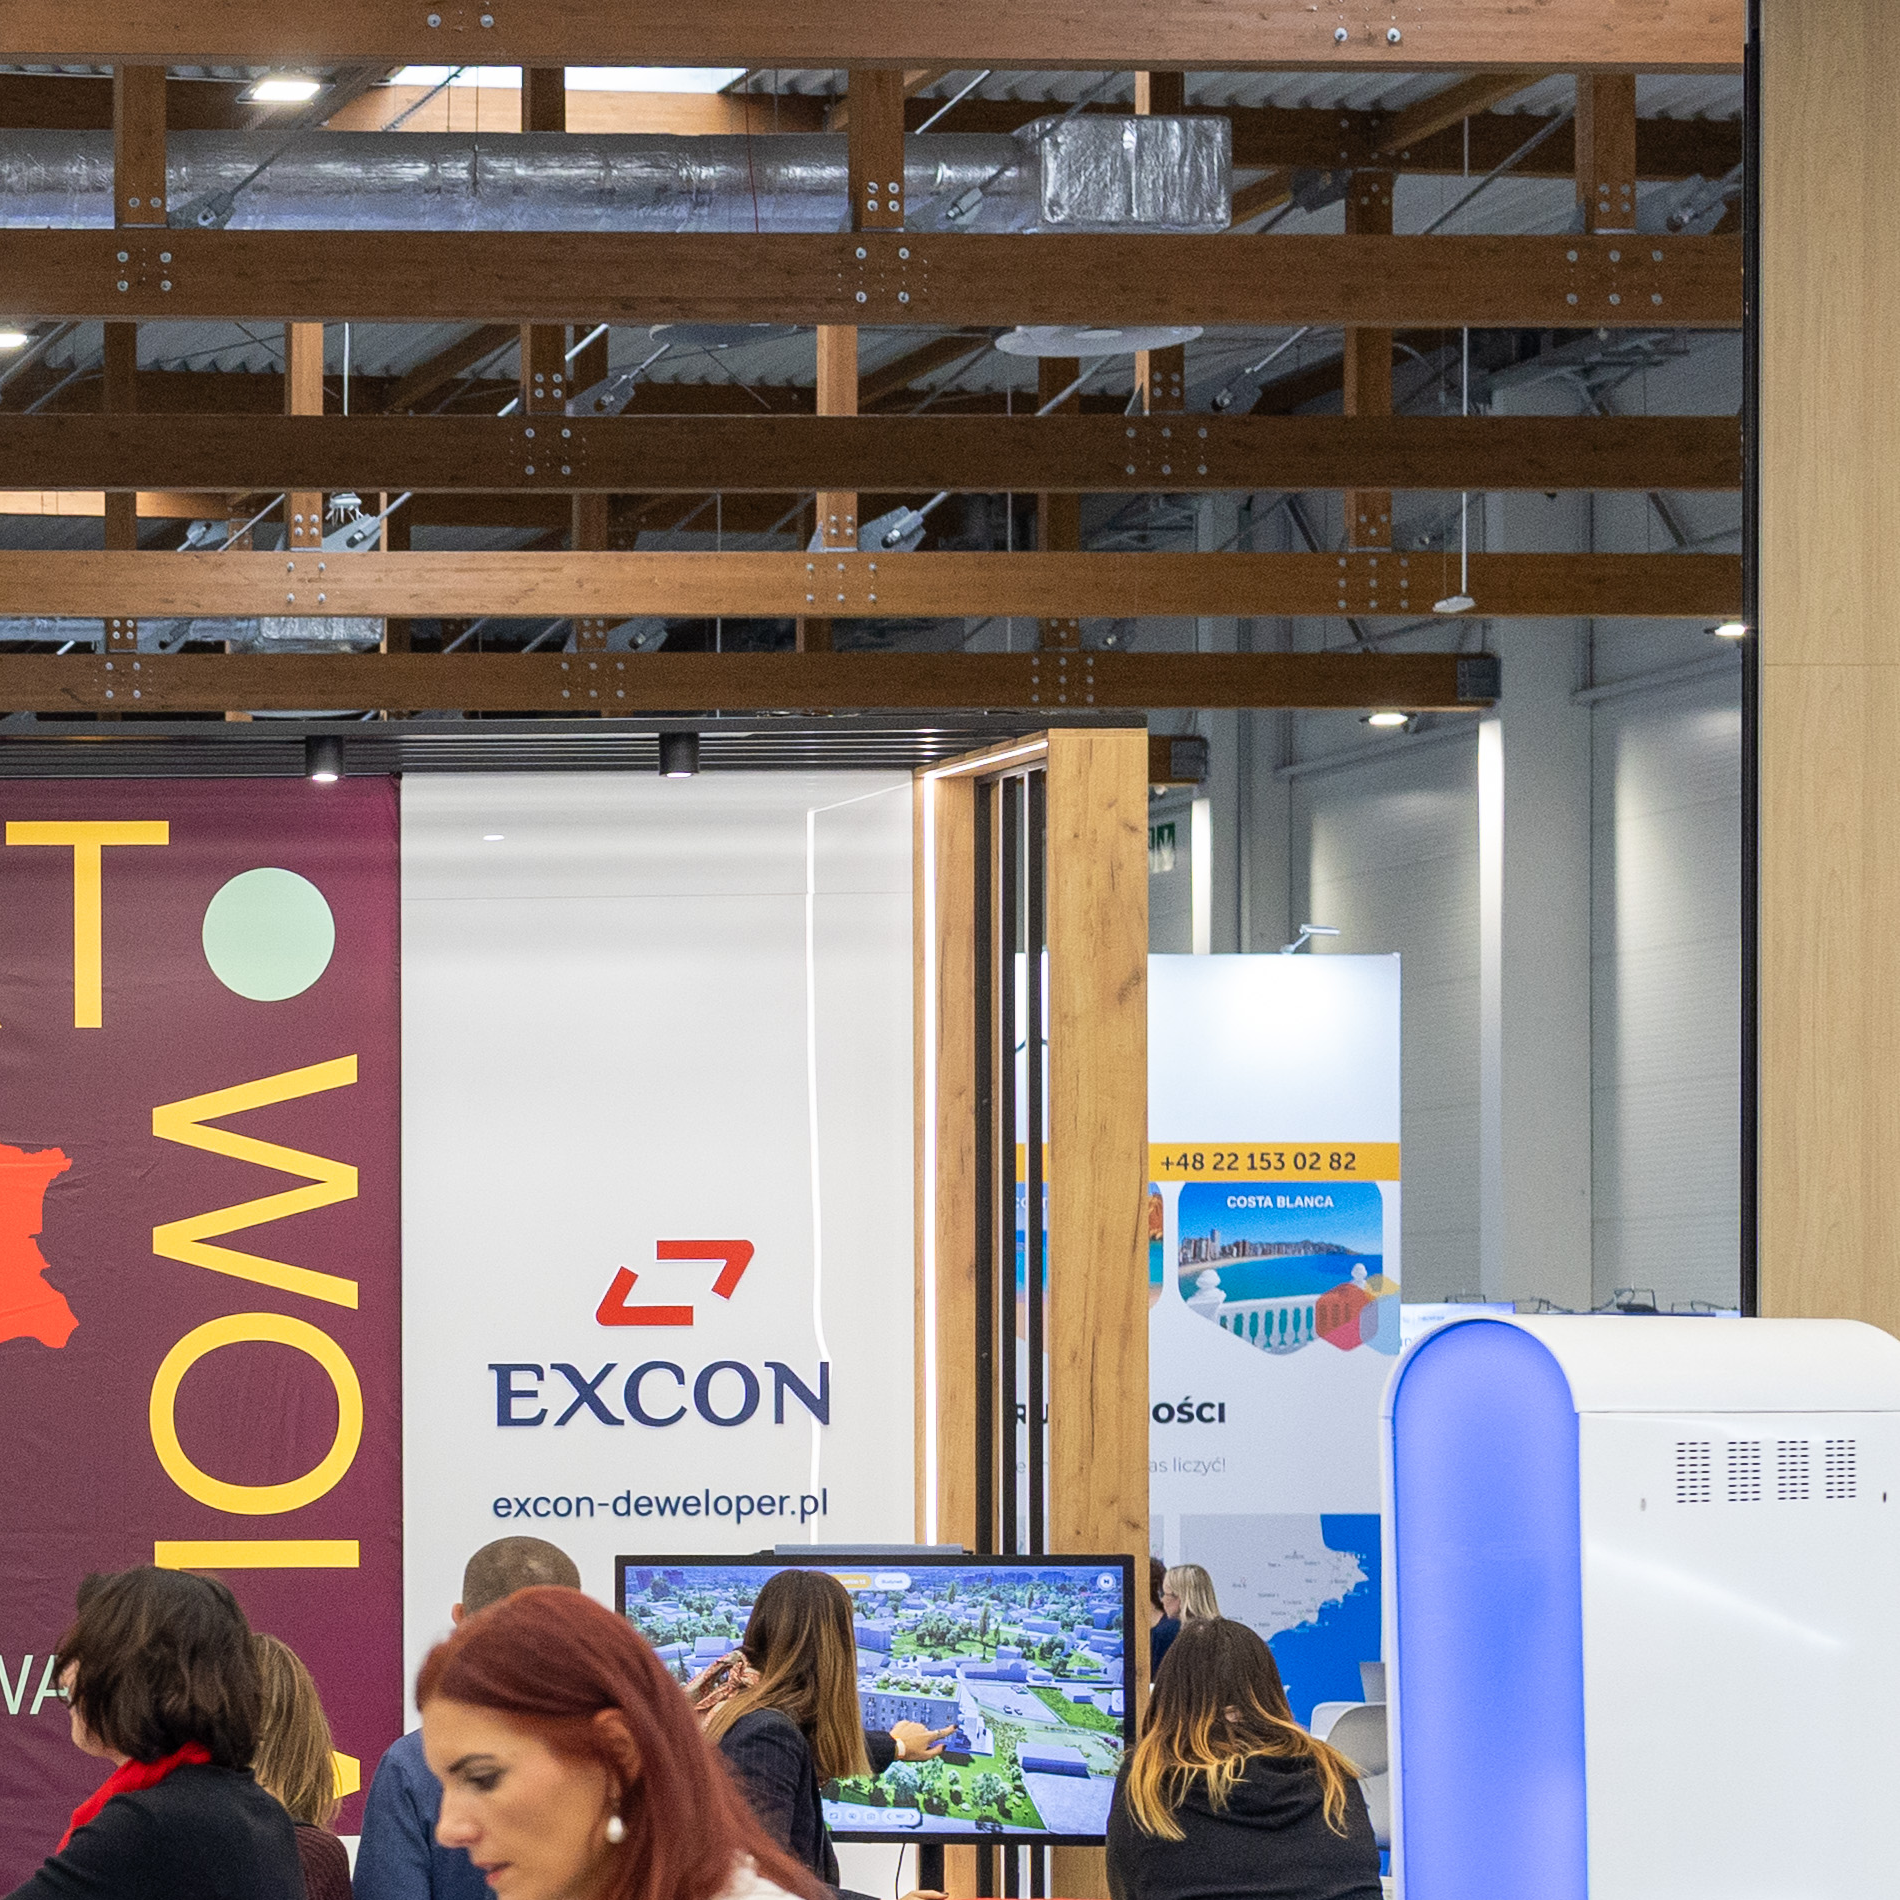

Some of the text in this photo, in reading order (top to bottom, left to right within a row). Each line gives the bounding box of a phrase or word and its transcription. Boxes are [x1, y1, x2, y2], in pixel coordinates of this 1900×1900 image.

[1161, 1152, 1357, 1171] +48 22 153 02 82
[1227, 1195, 1335, 1209] COSTA BLANCA
[487, 1360, 831, 1429] EXCON
[1172, 1457, 1227, 1476] liczyć!
[491, 1485, 830, 1525] excon-deweloper.pl
